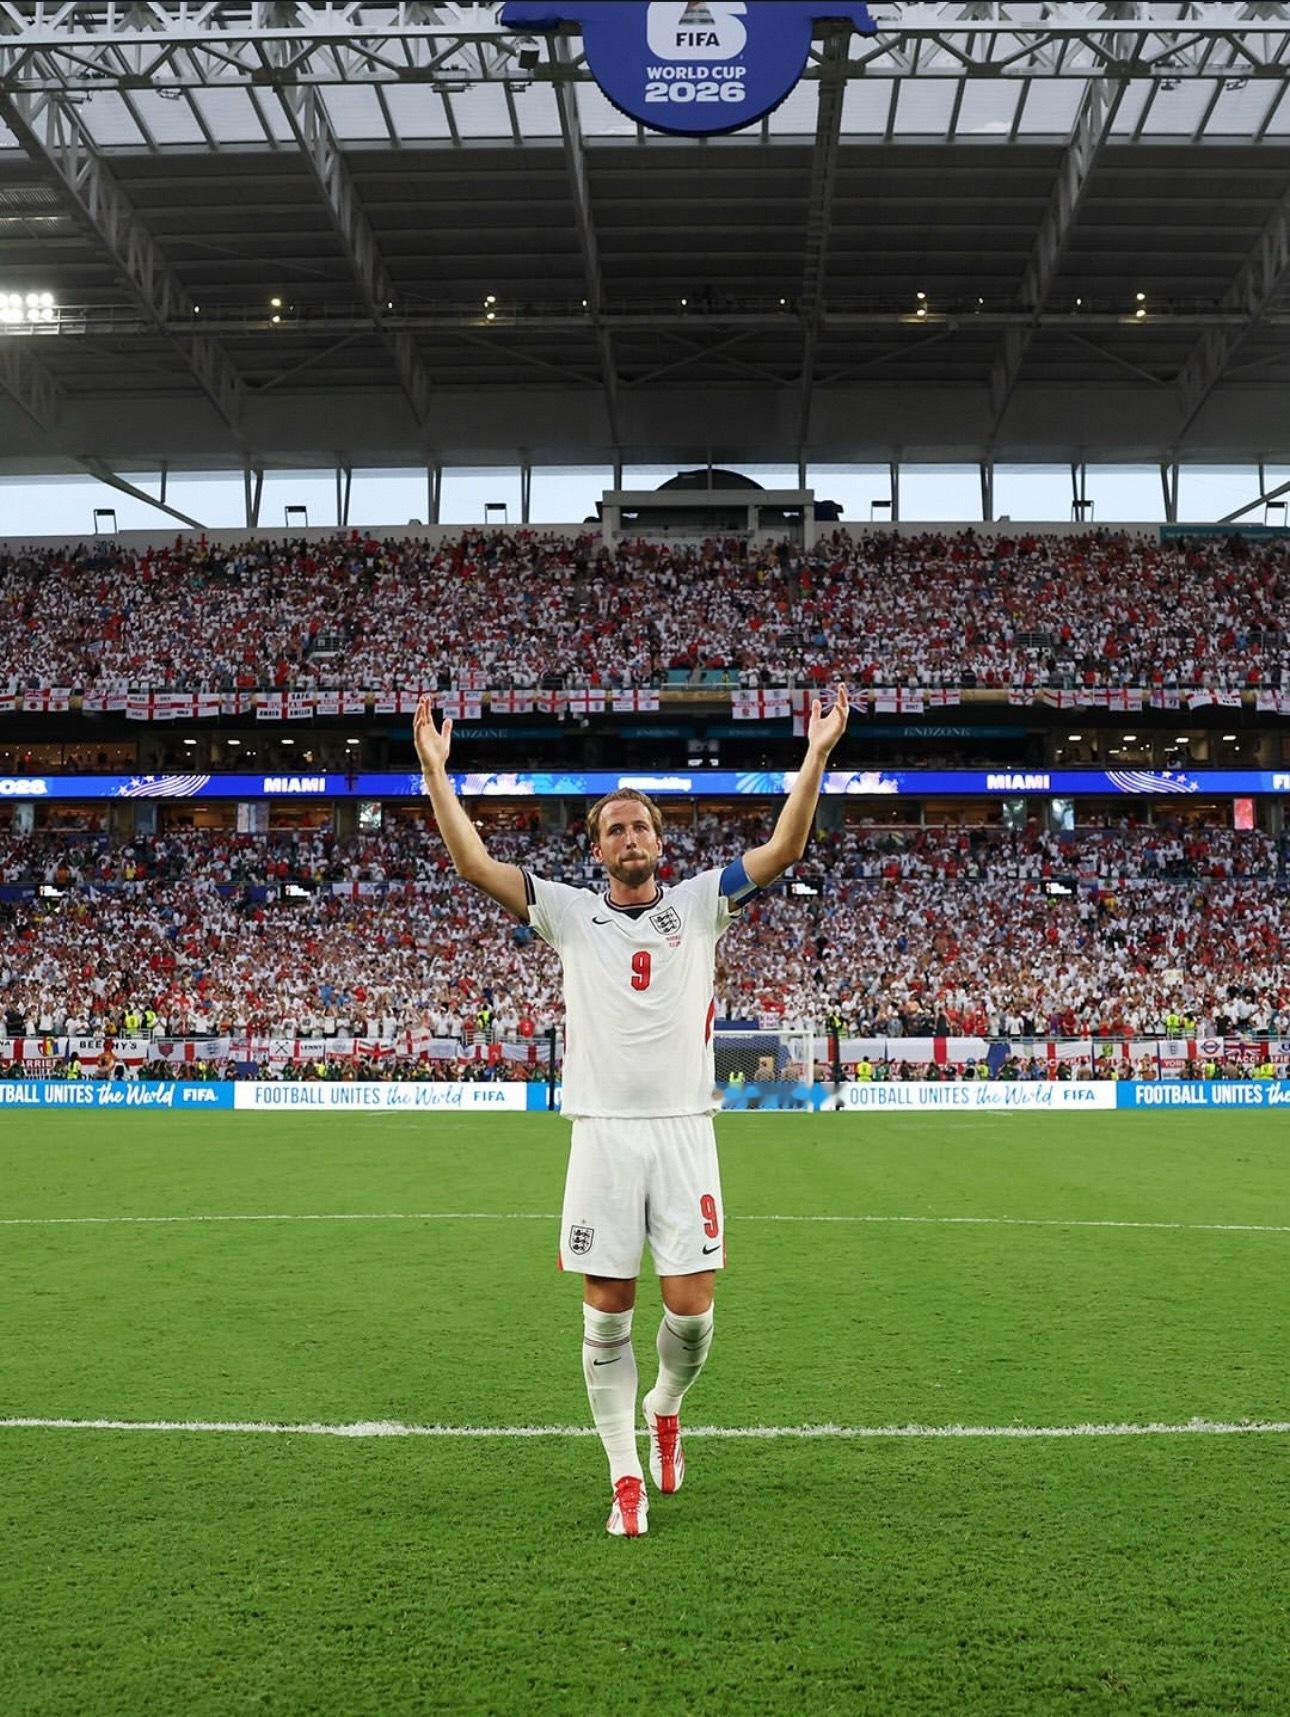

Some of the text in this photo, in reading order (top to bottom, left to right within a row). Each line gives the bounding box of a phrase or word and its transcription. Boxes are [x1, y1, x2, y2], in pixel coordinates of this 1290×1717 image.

[676, 32, 720, 47] FIFA
[647, 66, 747, 79] WORLD CUP
[645, 81, 746, 103] 2026
[263, 777, 326, 793] MIAMI
[986, 774, 1050, 790] MIAMI
[630, 950, 652, 992] 9
[44, 1084, 94, 1103] UNITES
[97, 1082, 124, 1105] the
[126, 1082, 176, 1107] World
[183, 1088, 217, 1102] FIFA
[255, 1083, 505, 1108] FOOTBALL UNITES the World FIFA
[850, 1083, 1096, 1107] OOTBALL UNITES the World FIFA
[1135, 1084, 1208, 1104] FOOTBALL
[1211, 1084, 1263, 1104] UNITES
[700, 1193, 720, 1239] 9
